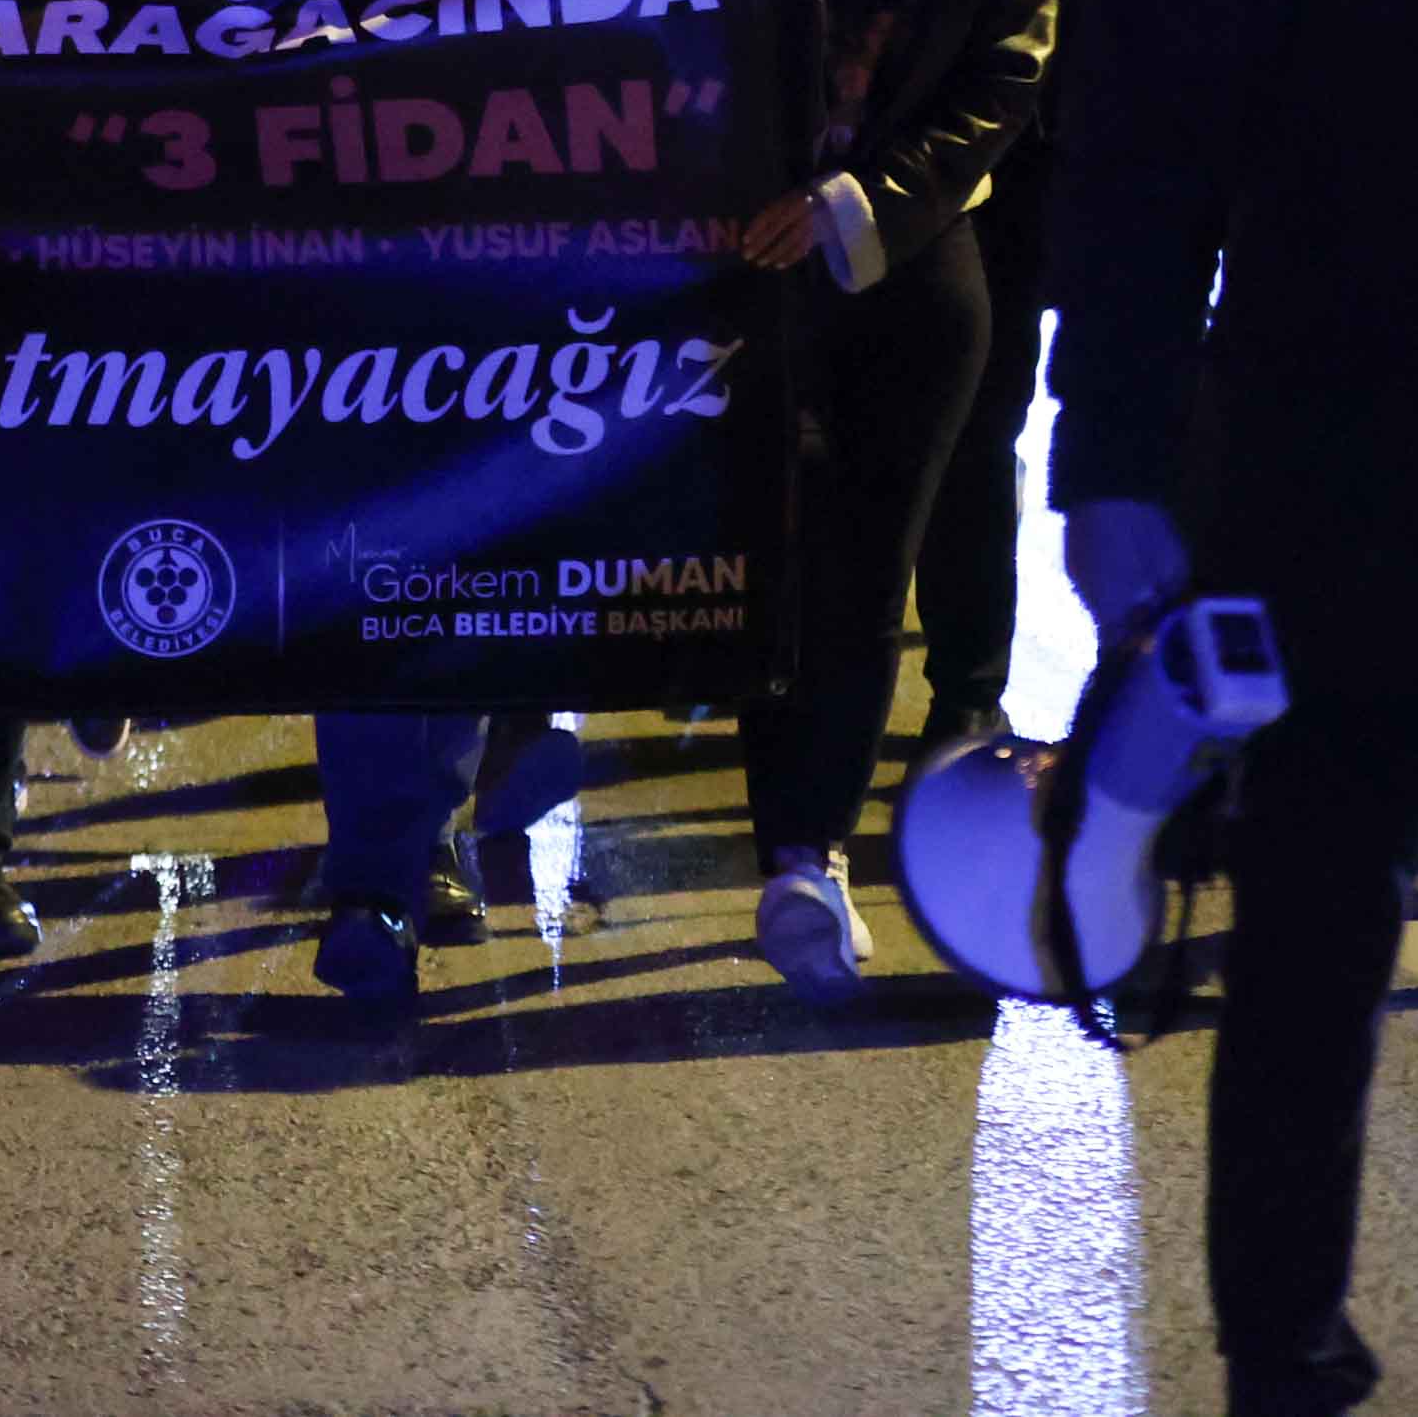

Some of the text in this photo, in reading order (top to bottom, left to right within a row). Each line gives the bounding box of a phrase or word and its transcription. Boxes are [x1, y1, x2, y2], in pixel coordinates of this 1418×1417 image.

[37, 222, 236, 270] HÜSEYİN
[250, 221, 364, 268] İNAN
[417, 221, 572, 262] YUSUF
[584, 217, 741, 257] ASLAN
[126, 528, 205, 553] BUCA
[364, 552, 746, 603] Görkem DUMAN
[362, 603, 744, 642] BUCA BELEDİYE BAŞKANI
